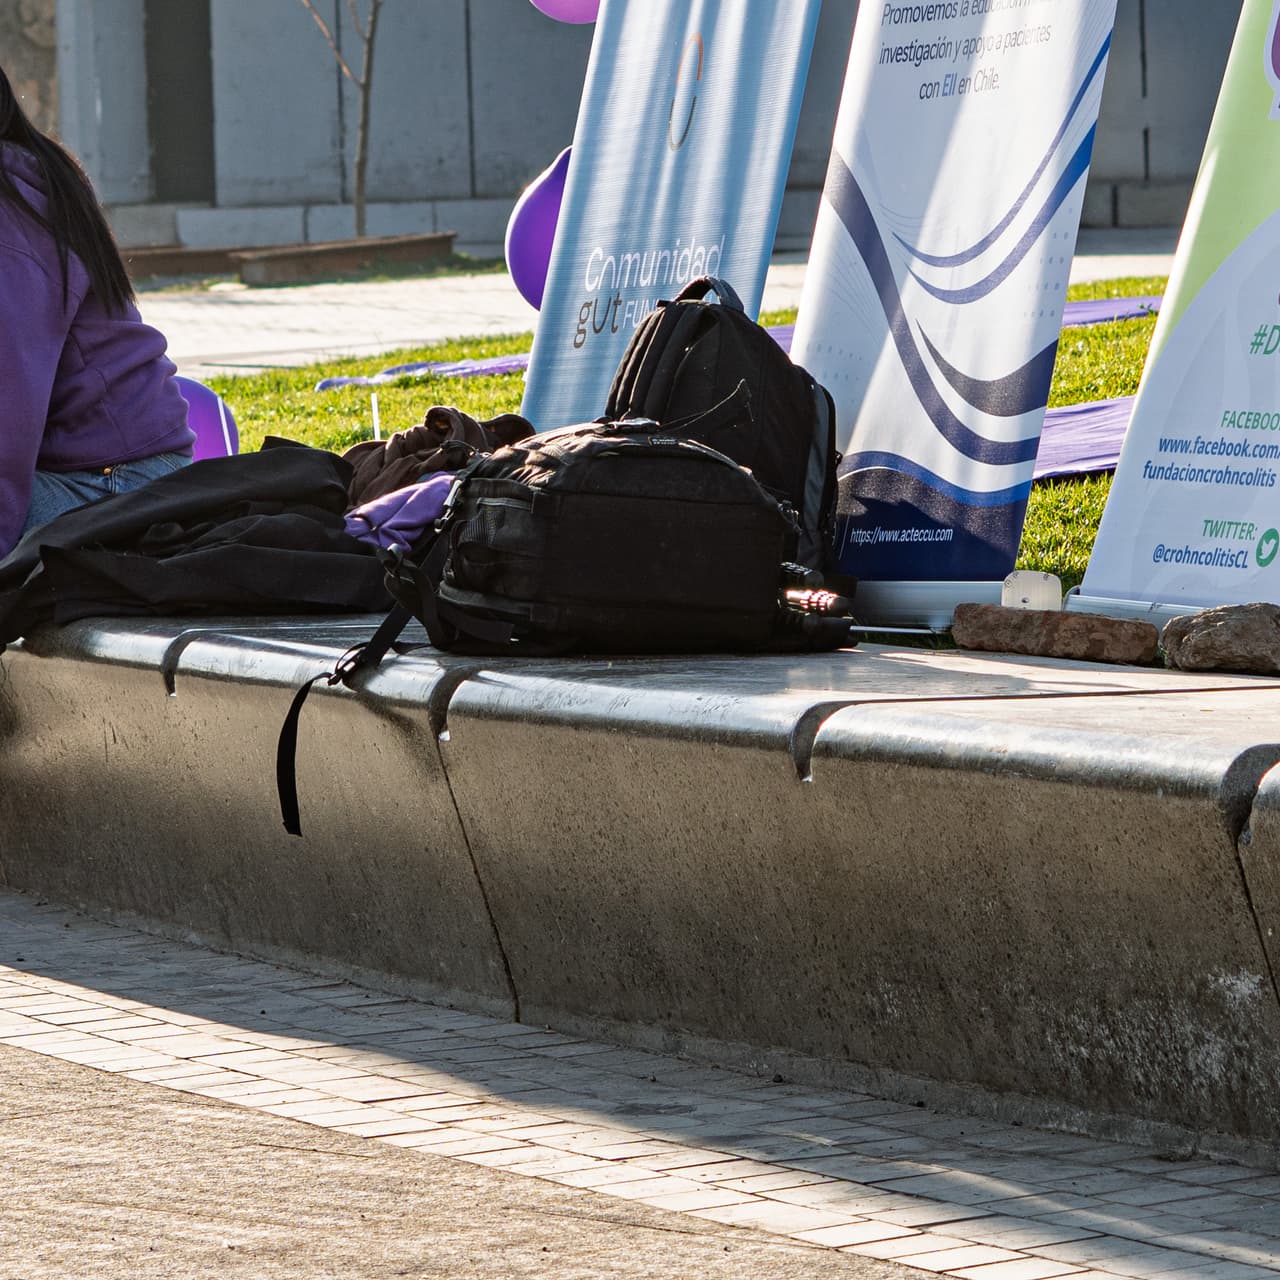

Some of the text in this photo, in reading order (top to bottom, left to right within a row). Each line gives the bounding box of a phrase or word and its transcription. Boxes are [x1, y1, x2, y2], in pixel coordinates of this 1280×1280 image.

[881, 0, 959, 26] Promovemos
[878, 35, 953, 67] investigación
[952, 38, 962, 64] y
[962, 34, 995, 62] apoyo
[995, 33, 1003, 50] a
[919, 81, 940, 100] con
[957, 75, 972, 95] en
[1142, 460, 1276, 488] fundacioncrohncolitis
[850, 526, 953, 546] https://www.acteccu.com
[1201, 519, 1258, 541] TWITTER:
[1152, 543, 1249, 569] @crohncolitisCL
